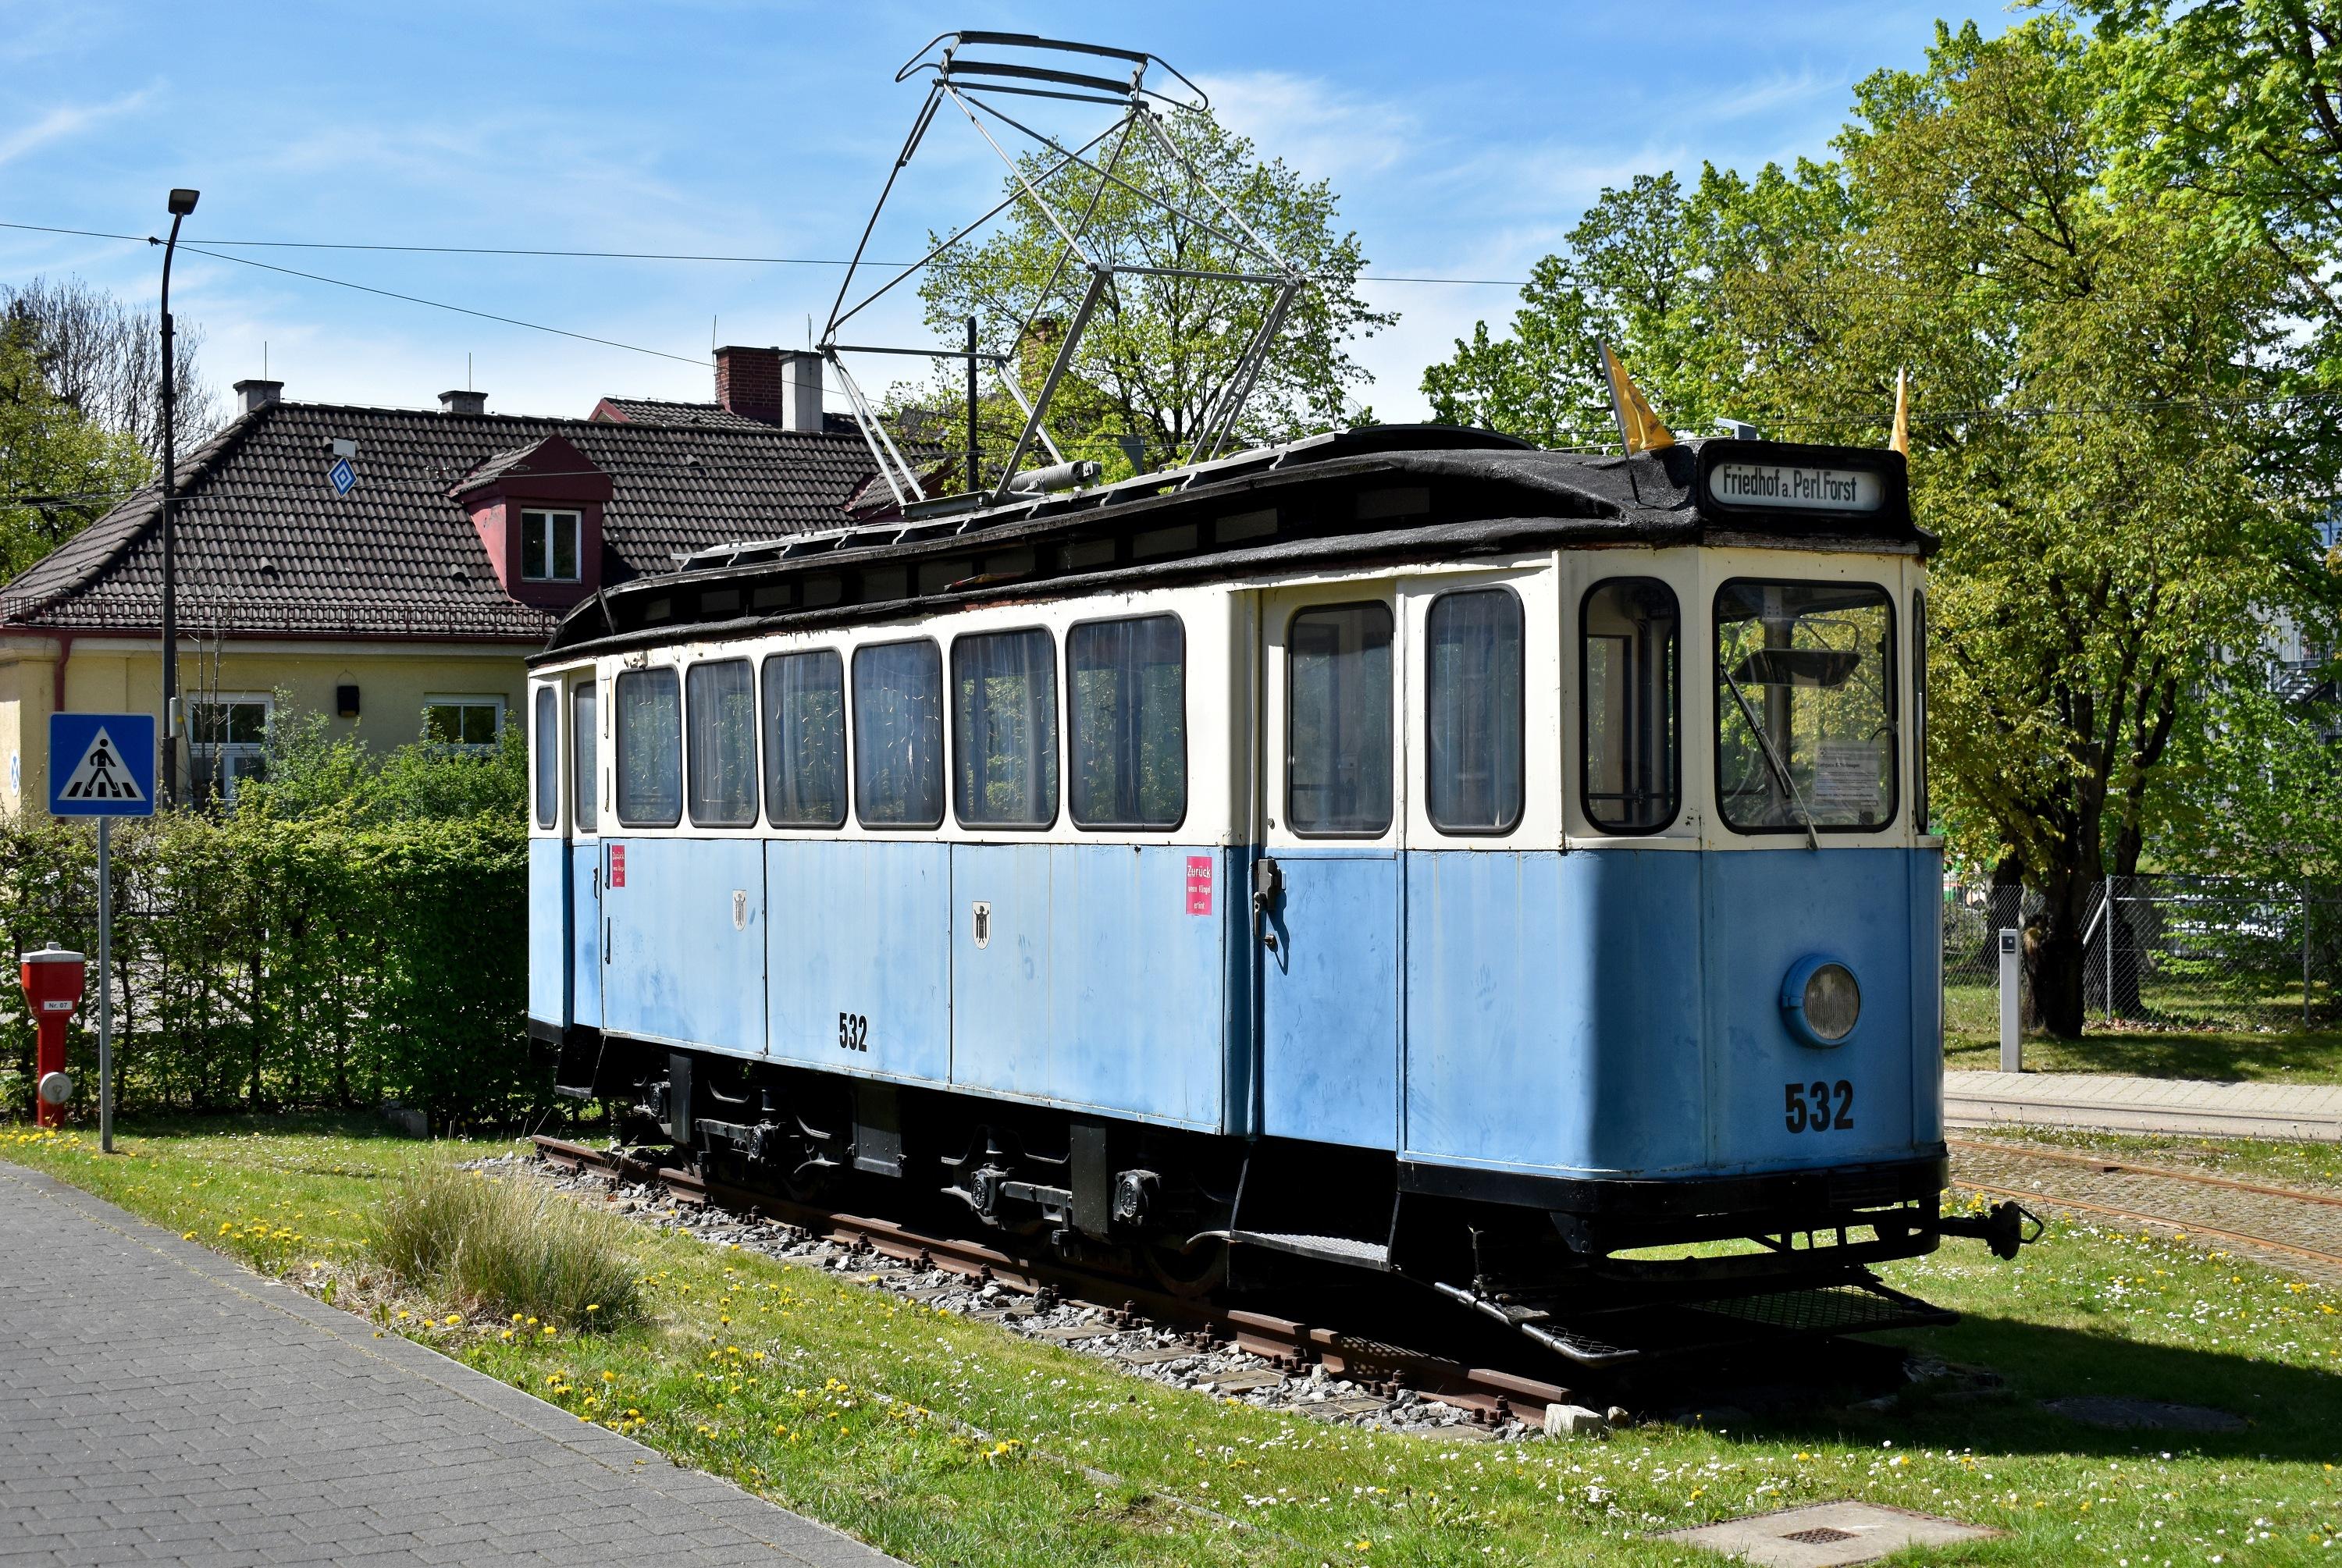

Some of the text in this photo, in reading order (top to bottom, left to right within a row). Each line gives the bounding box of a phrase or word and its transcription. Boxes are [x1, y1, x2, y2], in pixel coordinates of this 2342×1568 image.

[1723, 465, 1779, 496] Friedhof
[1781, 482, 1791, 498] a.
[1187, 865, 1211, 879] Zurück
[839, 1012, 867, 1053] 532
[1785, 1079, 1854, 1134] 532
